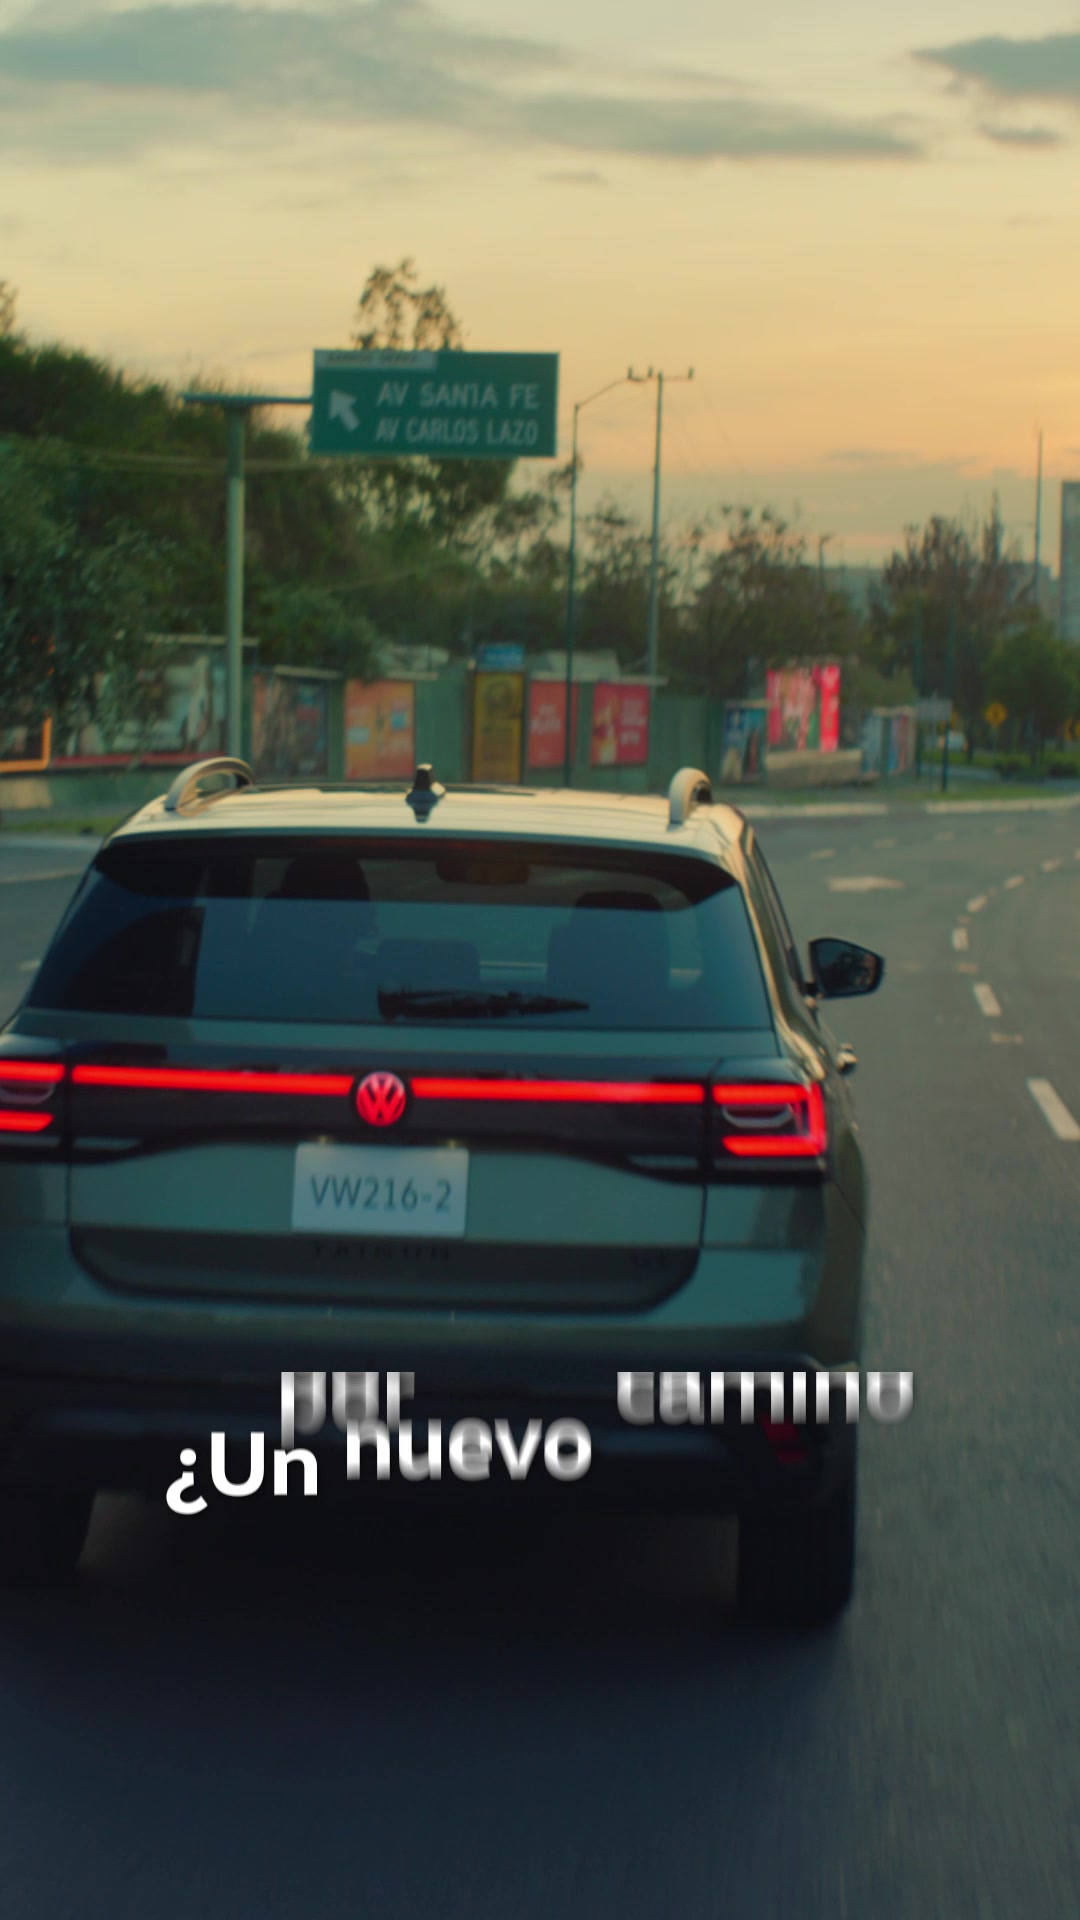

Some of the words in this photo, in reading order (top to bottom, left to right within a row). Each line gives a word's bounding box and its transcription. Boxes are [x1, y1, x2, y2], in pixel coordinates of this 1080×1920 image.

[377, 382, 409, 407] AV
[420, 382, 498, 409] SANTA
[509, 383, 540, 409] FE
[375, 416, 400, 443] AV
[406, 418, 480, 444] CARLOS
[486, 419, 539, 446] LAZO
[311, 1174, 452, 1214] VW216-2
